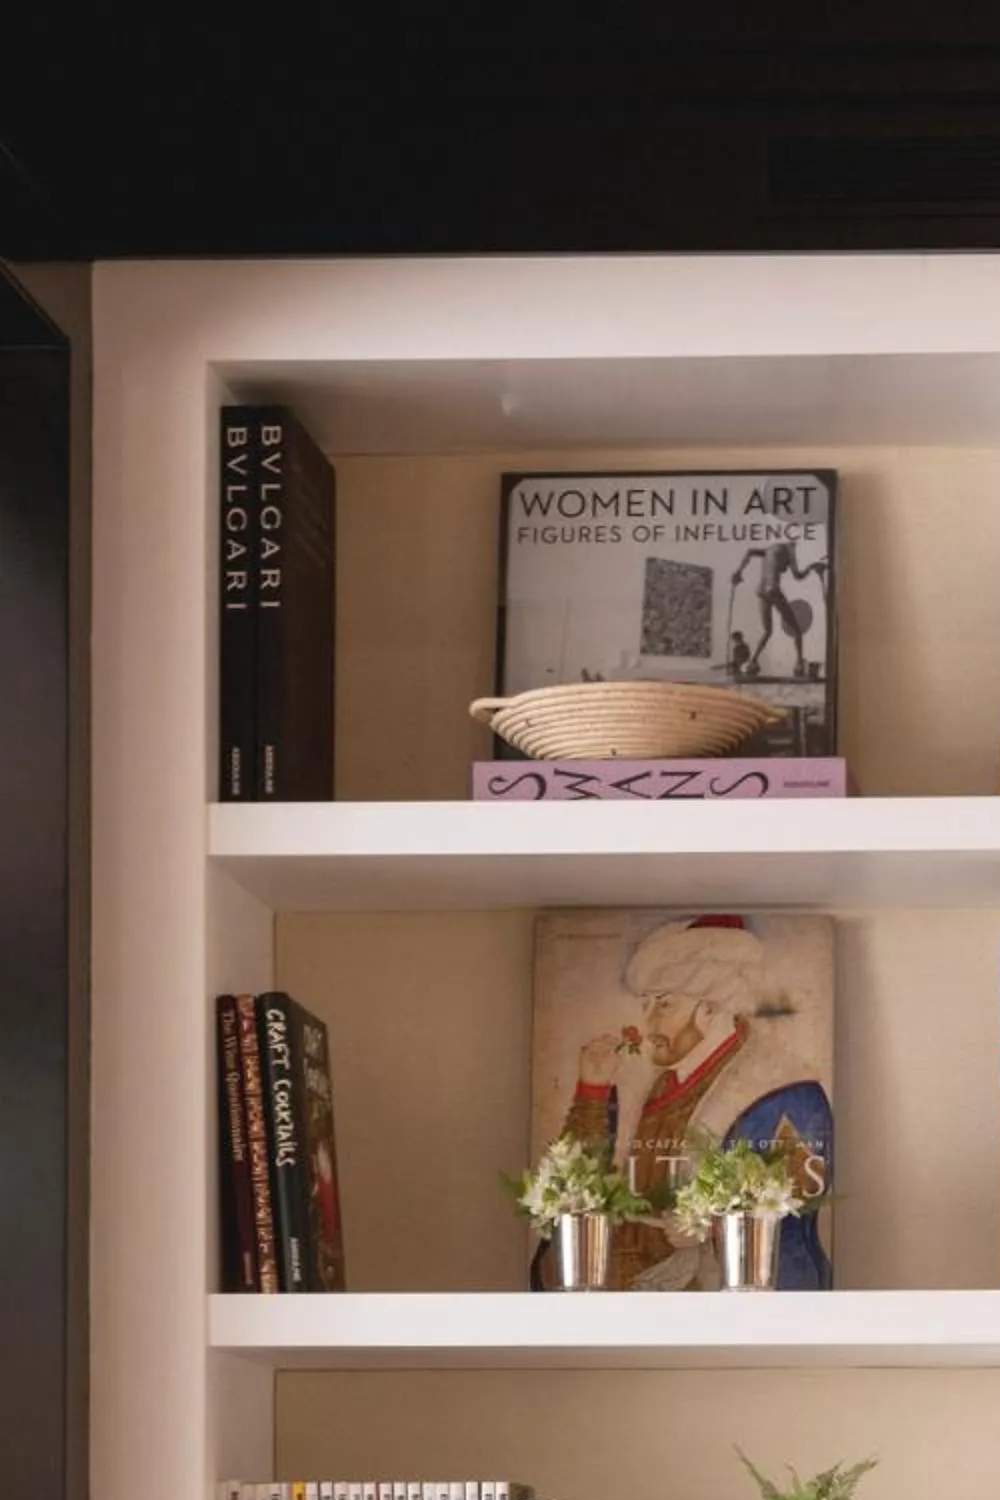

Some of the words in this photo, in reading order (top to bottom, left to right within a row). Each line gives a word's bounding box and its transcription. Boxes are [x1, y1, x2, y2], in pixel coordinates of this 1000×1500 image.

[226, 426, 248, 610] BVLGARI
[260, 425, 282, 608] BVLGARI
[518, 488, 674, 519] WOMEN
[691, 487, 727, 516] IN
[744, 486, 817, 515] ART
[517, 525, 622, 545] FIGURES
[631, 525, 665, 544] OF
[674, 523, 817, 542] INFLUENCE
[487, 768, 769, 800] SWANS
[265, 1008, 291, 1072] CRAFT
